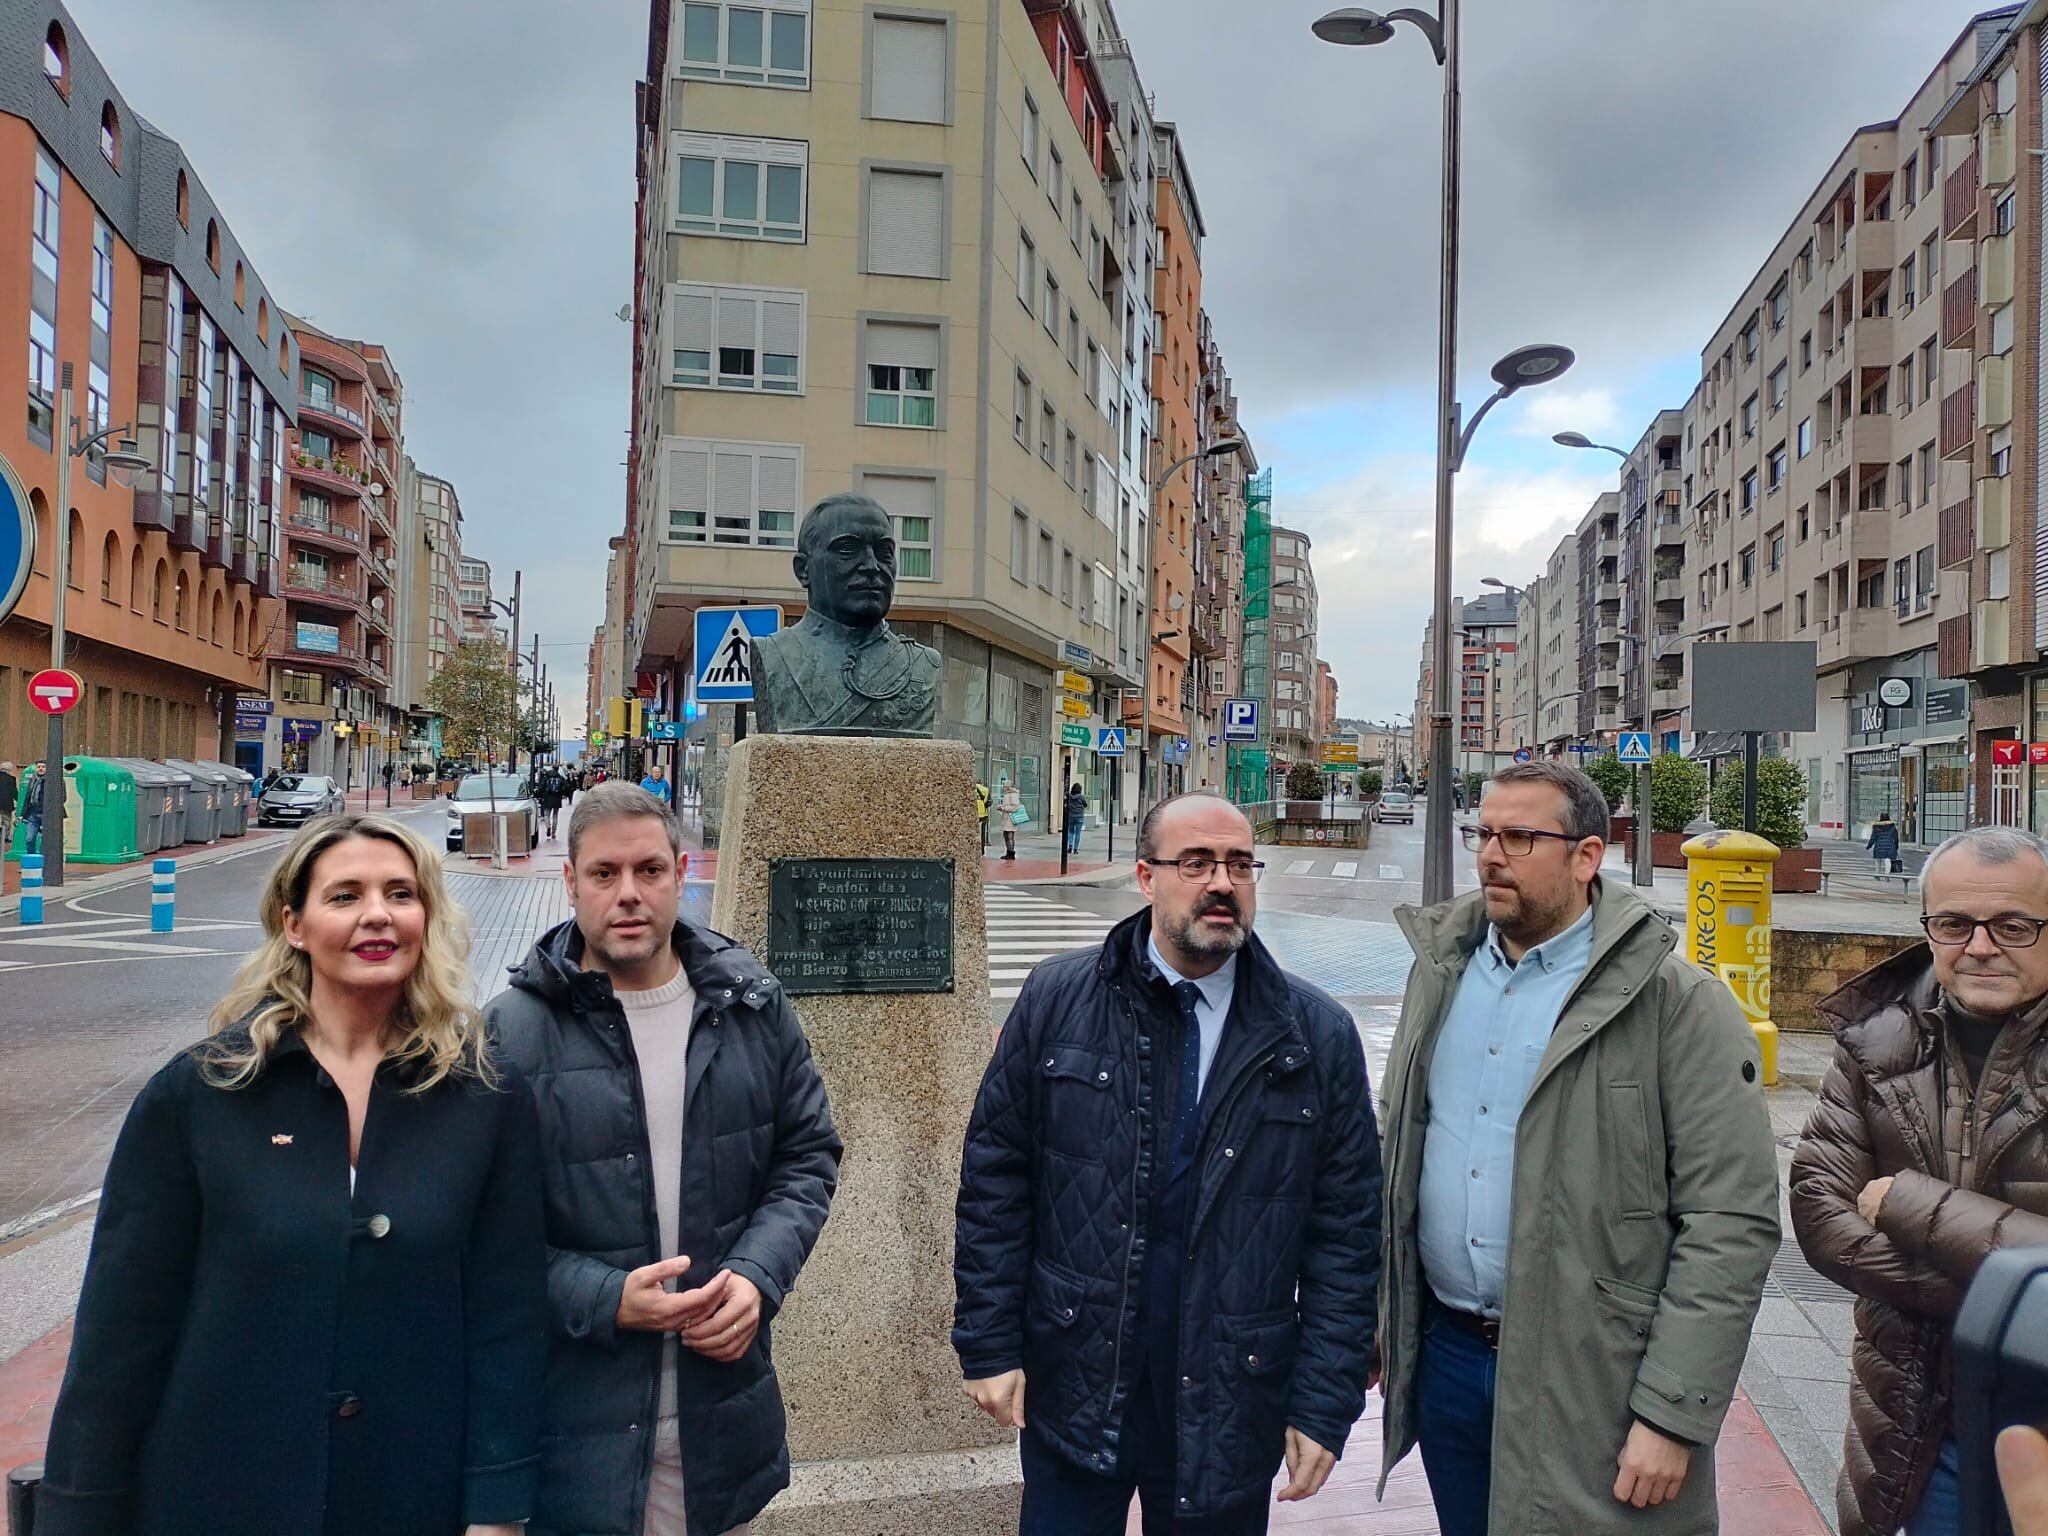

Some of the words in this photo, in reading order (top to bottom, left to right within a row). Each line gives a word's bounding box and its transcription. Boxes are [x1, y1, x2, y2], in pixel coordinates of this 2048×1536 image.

[1231, 703, 1251, 725] P
[1861, 705, 1883, 732] P&G
[665, 725, 675, 738] S
[808, 866, 907, 881] Ayuntamiento
[817, 881, 894, 894] Ponferrda
[802, 962, 848, 977] Bierzo
